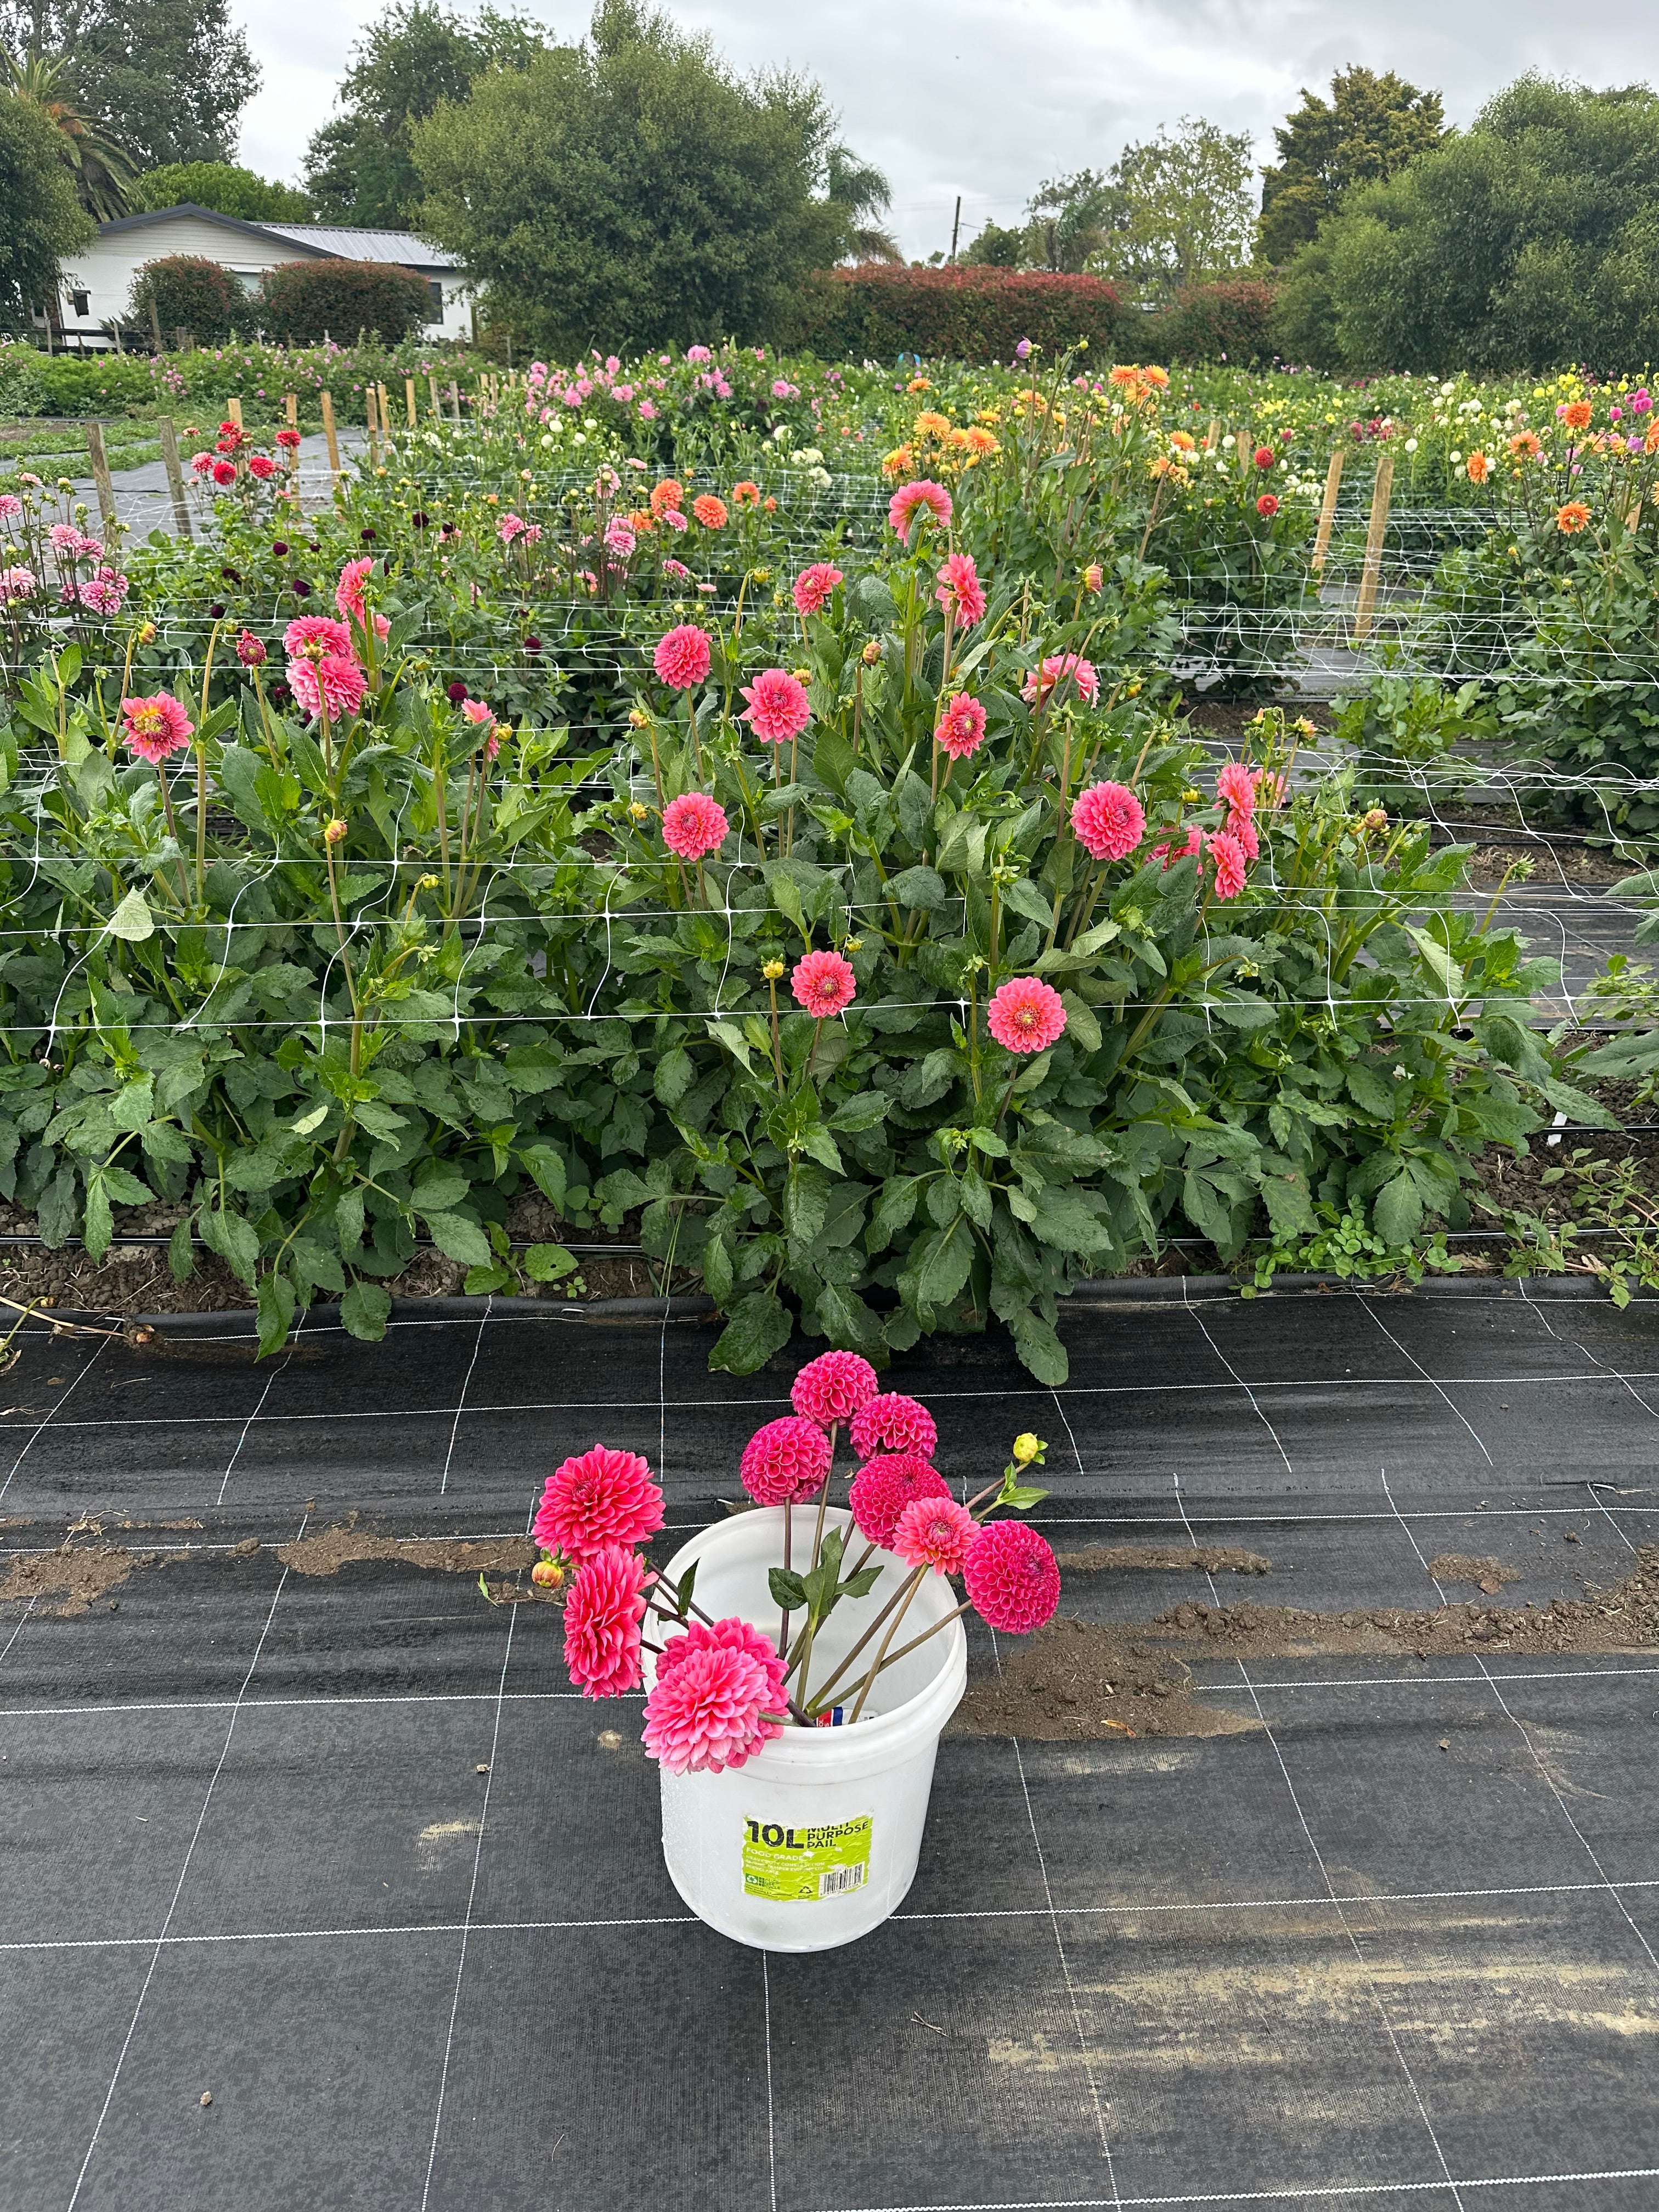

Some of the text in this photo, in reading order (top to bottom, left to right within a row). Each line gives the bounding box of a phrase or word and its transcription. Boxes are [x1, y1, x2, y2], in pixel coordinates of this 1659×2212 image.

[747, 1820, 804, 1849] 10L
[808, 1821, 868, 1841] PURPOSE
[807, 1839, 837, 1849] PAIL
[746, 1847, 804, 1861] FOOD GRADE
